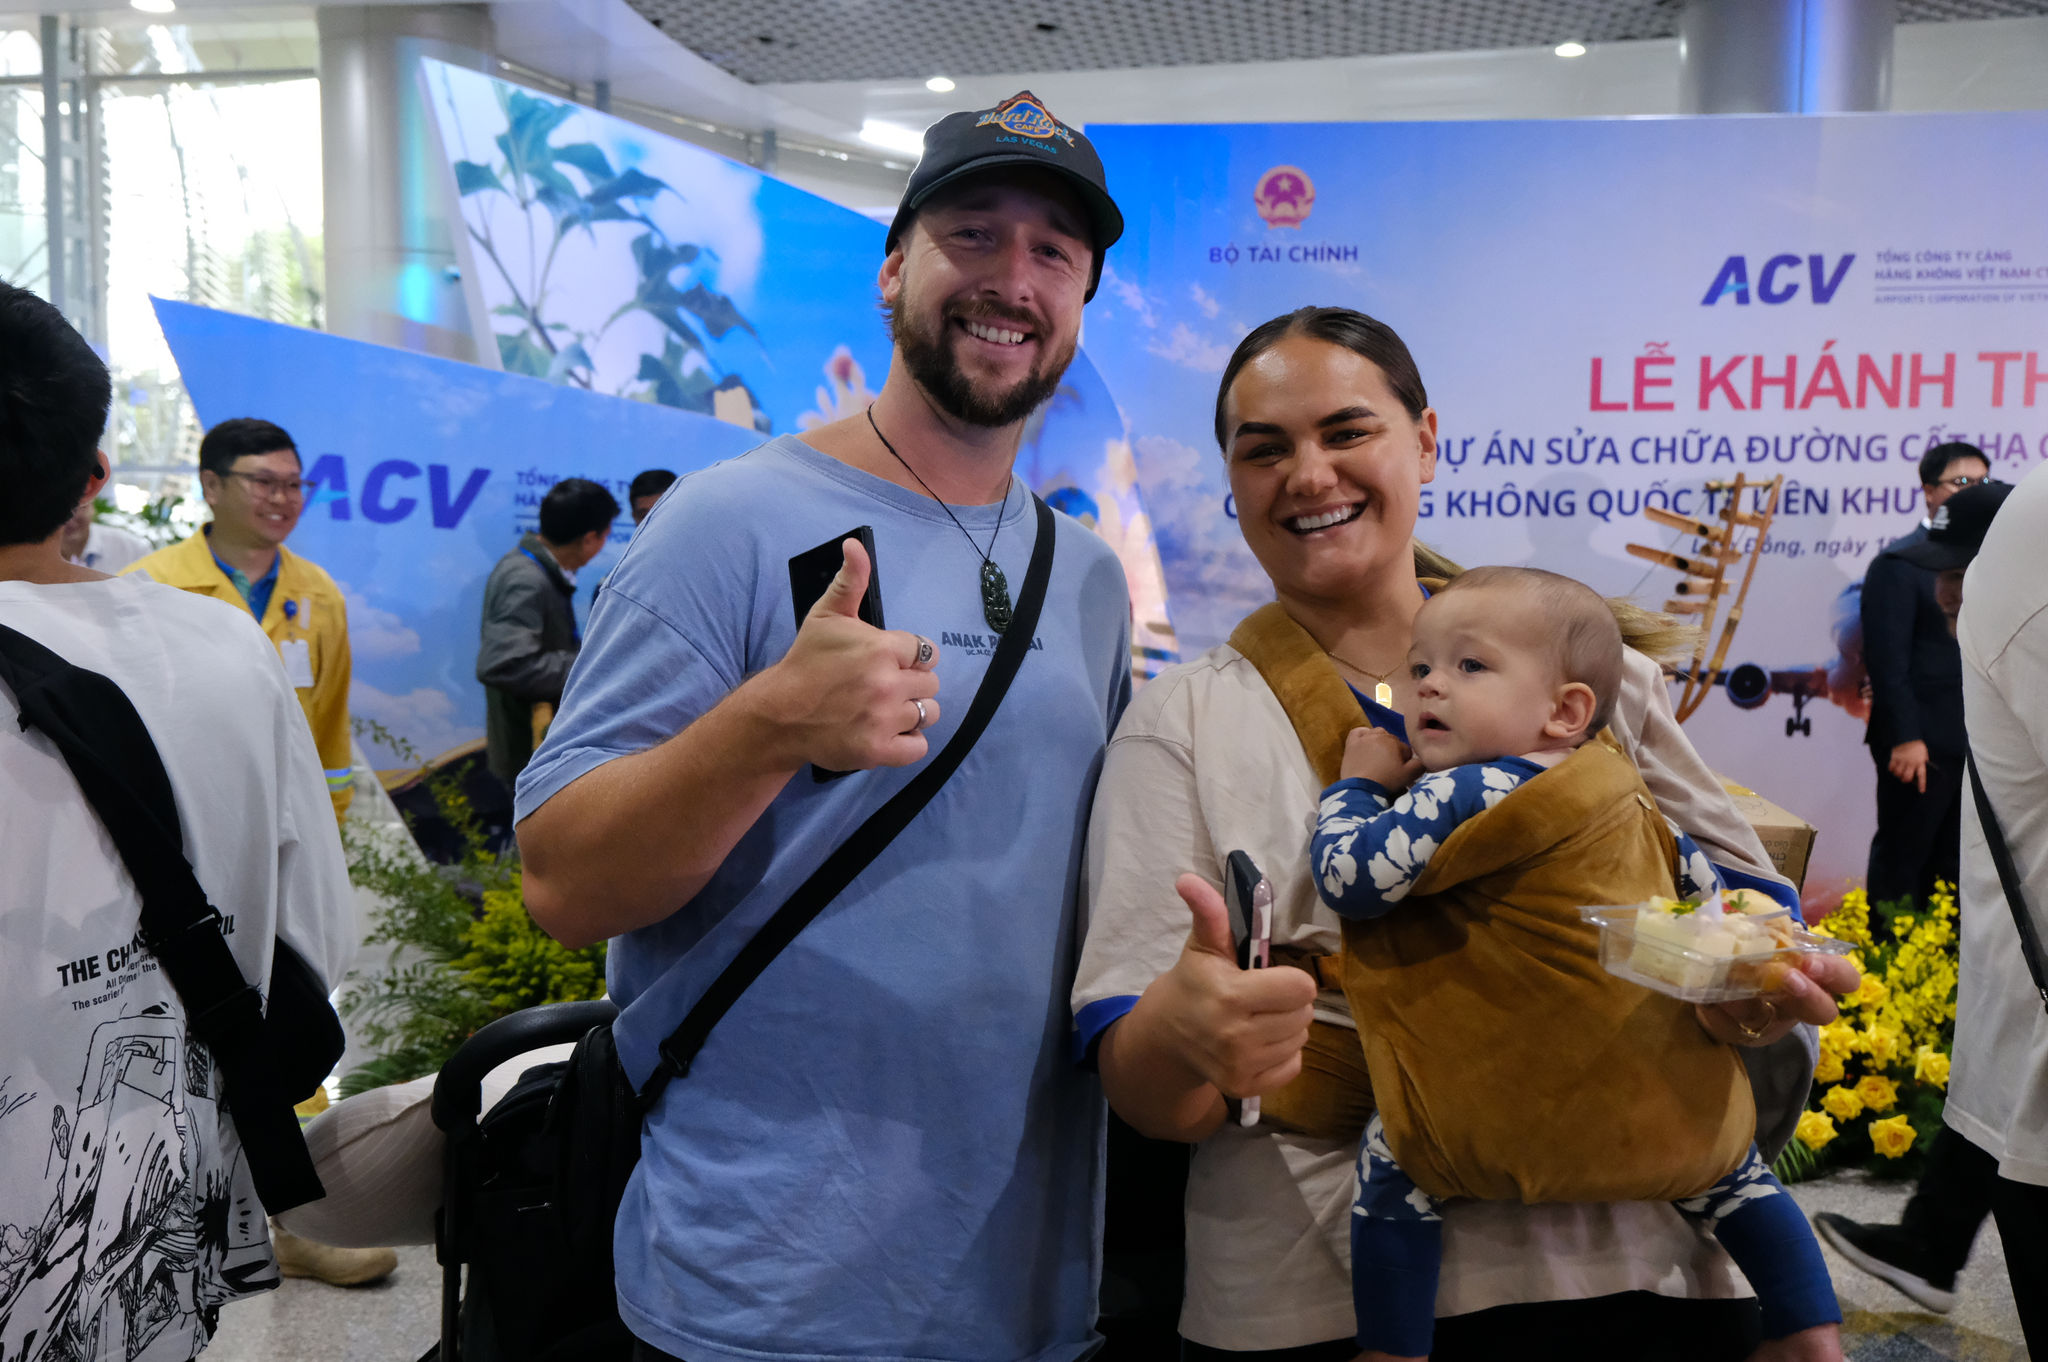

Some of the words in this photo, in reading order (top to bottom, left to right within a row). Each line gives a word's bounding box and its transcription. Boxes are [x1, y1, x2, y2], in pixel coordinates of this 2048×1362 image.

[1021, 137, 1057, 154] VEGAS
[1209, 242, 1240, 268] BỘ
[1288, 241, 1358, 263] CHÍNH
[1700, 254, 1856, 306] ACV
[1589, 342, 1675, 412] LỄ
[1698, 339, 1956, 411] KHÁNH
[1483, 430, 1534, 465] ÁN
[1545, 427, 1620, 465] SỬA
[1630, 428, 1735, 464] CHỮA
[1746, 427, 1887, 463] ĐƯỜNG
[1980, 433, 2028, 468] HẠ
[300, 454, 492, 530] ACV
[1447, 481, 1576, 517] KHÔNG
[1588, 479, 1692, 522] QUỐC
[1814, 534, 1868, 557] ngày
[941, 631, 986, 649] ANAK
[57, 955, 102, 987] THE
[72, 998, 91, 1012] The
[92, 988, 121, 1007] scarier
